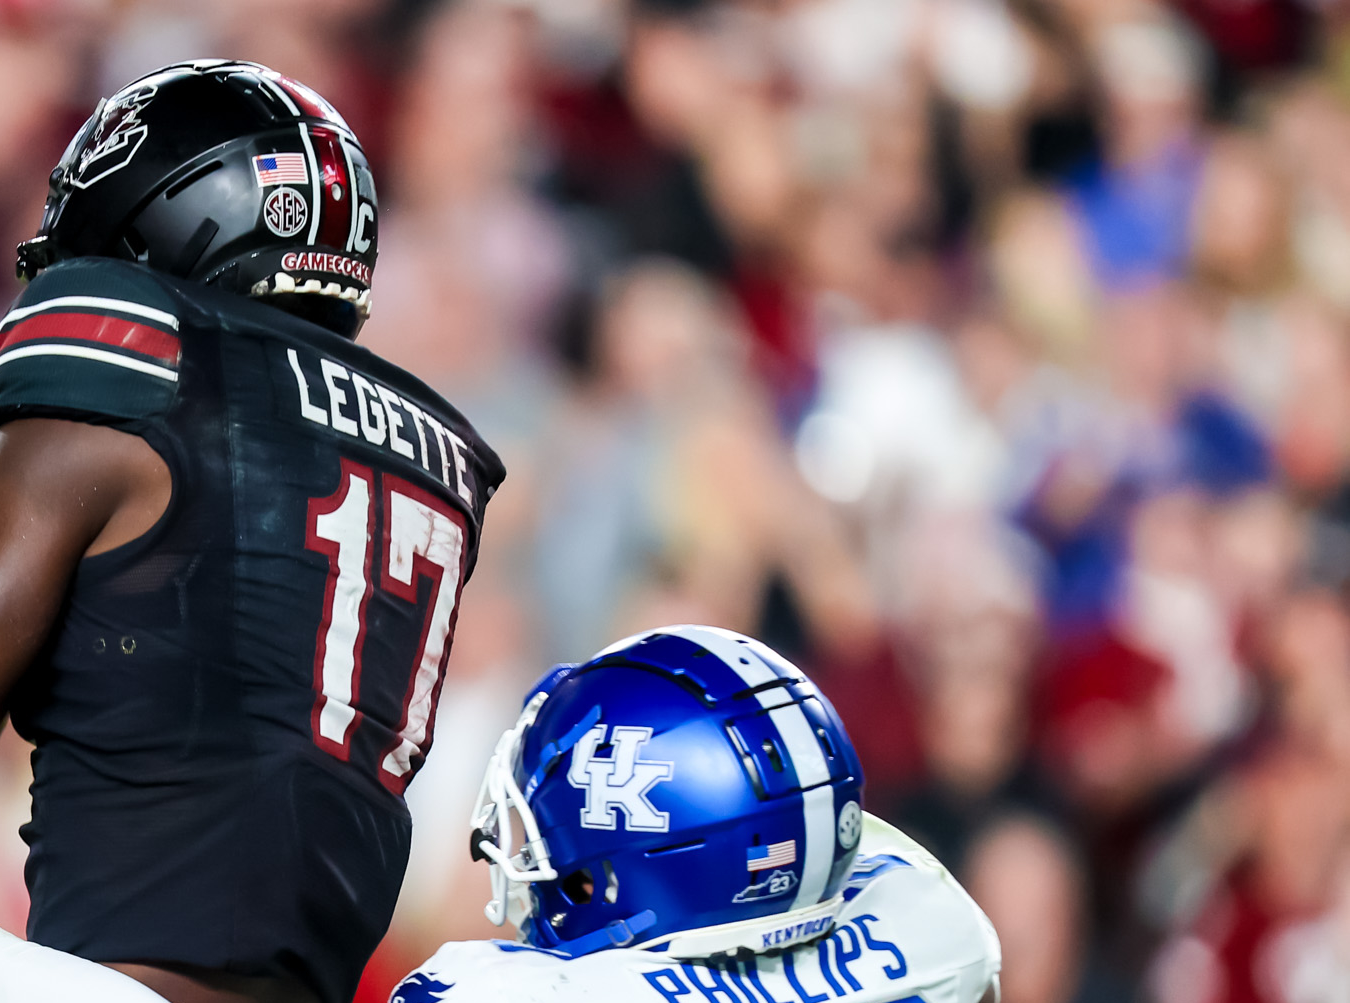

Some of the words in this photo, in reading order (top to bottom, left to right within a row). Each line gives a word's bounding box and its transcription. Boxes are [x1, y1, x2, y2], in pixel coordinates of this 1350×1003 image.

[265, 188, 307, 236] SEC
[354, 202, 374, 253] C
[286, 348, 473, 508] LEGETTE
[305, 456, 468, 796] 17
[567, 724, 675, 833] UK
[769, 875, 790, 894] 23
